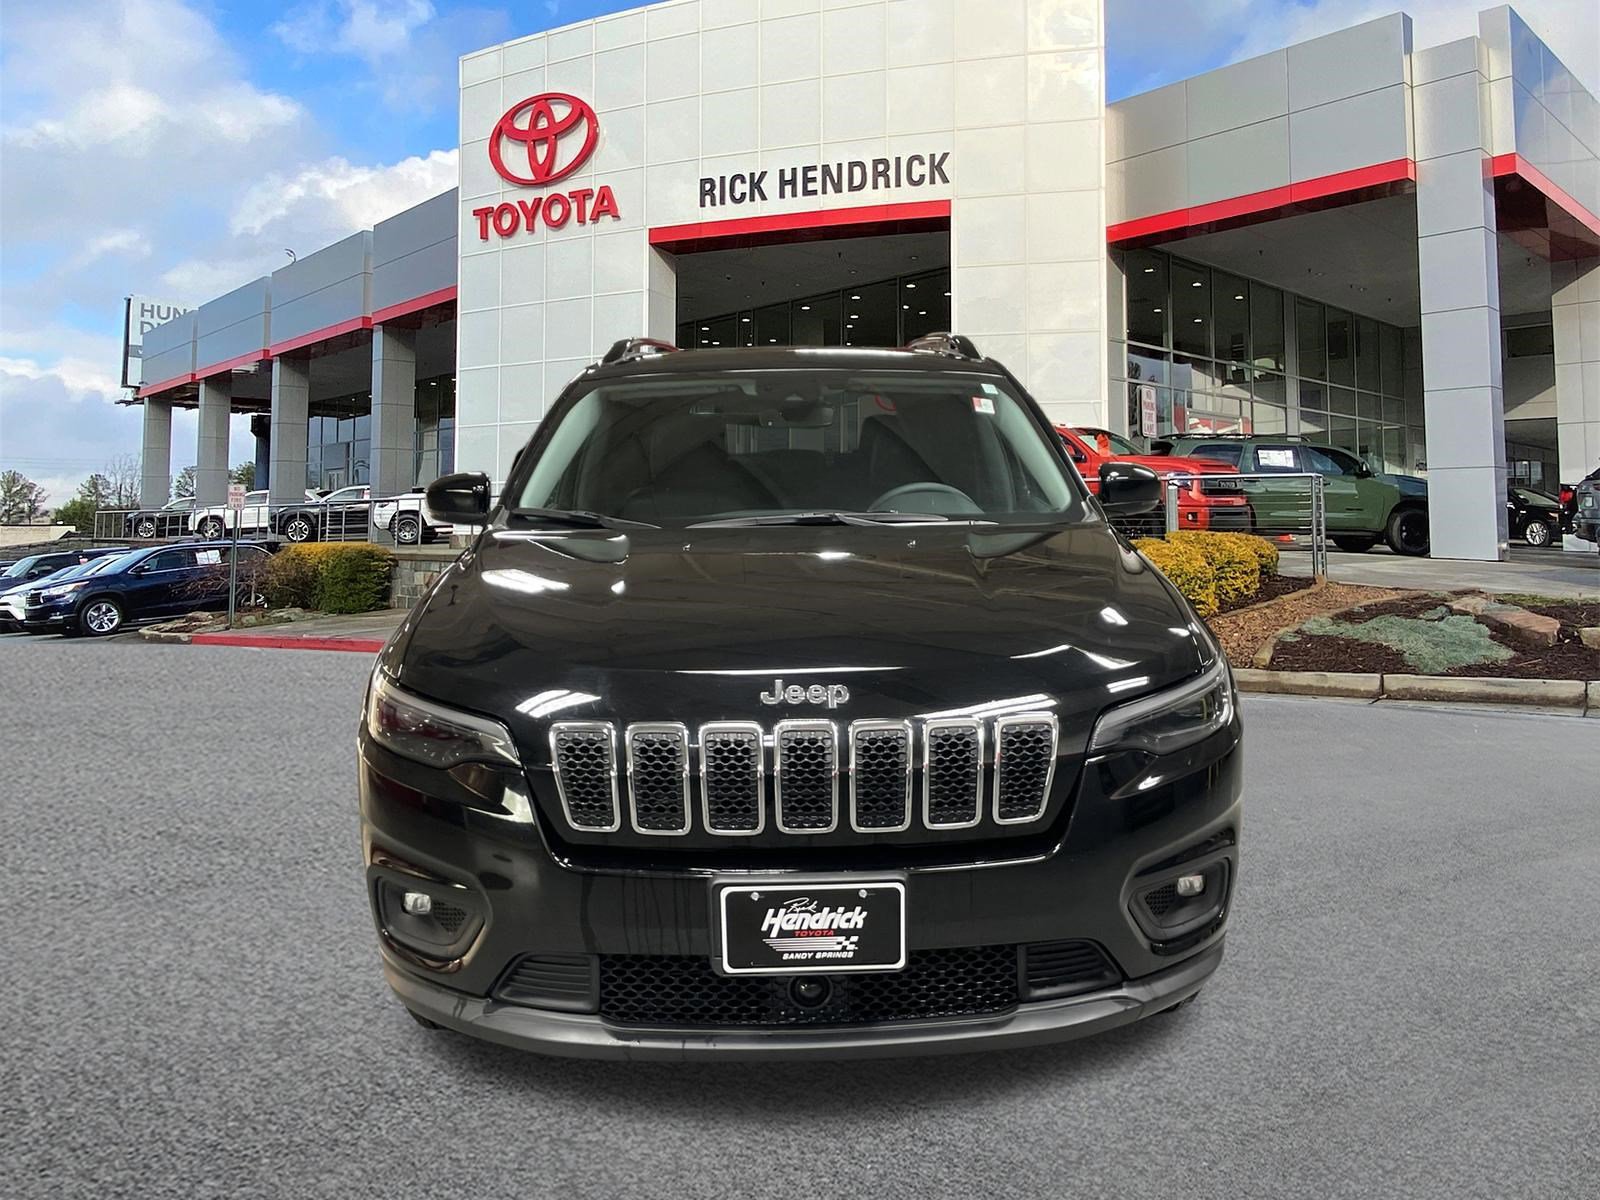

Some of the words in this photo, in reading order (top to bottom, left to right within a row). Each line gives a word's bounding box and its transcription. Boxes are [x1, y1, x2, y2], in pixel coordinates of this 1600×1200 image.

[699, 171, 768, 207] RICK
[778, 152, 951, 200] HENDRICK
[472, 185, 621, 241] TOYOTA
[760, 679, 850, 709] Jeep
[760, 906, 868, 938] Hendrick
[782, 952, 814, 961] SANDY
[815, 951, 854, 960] SPRINGS
